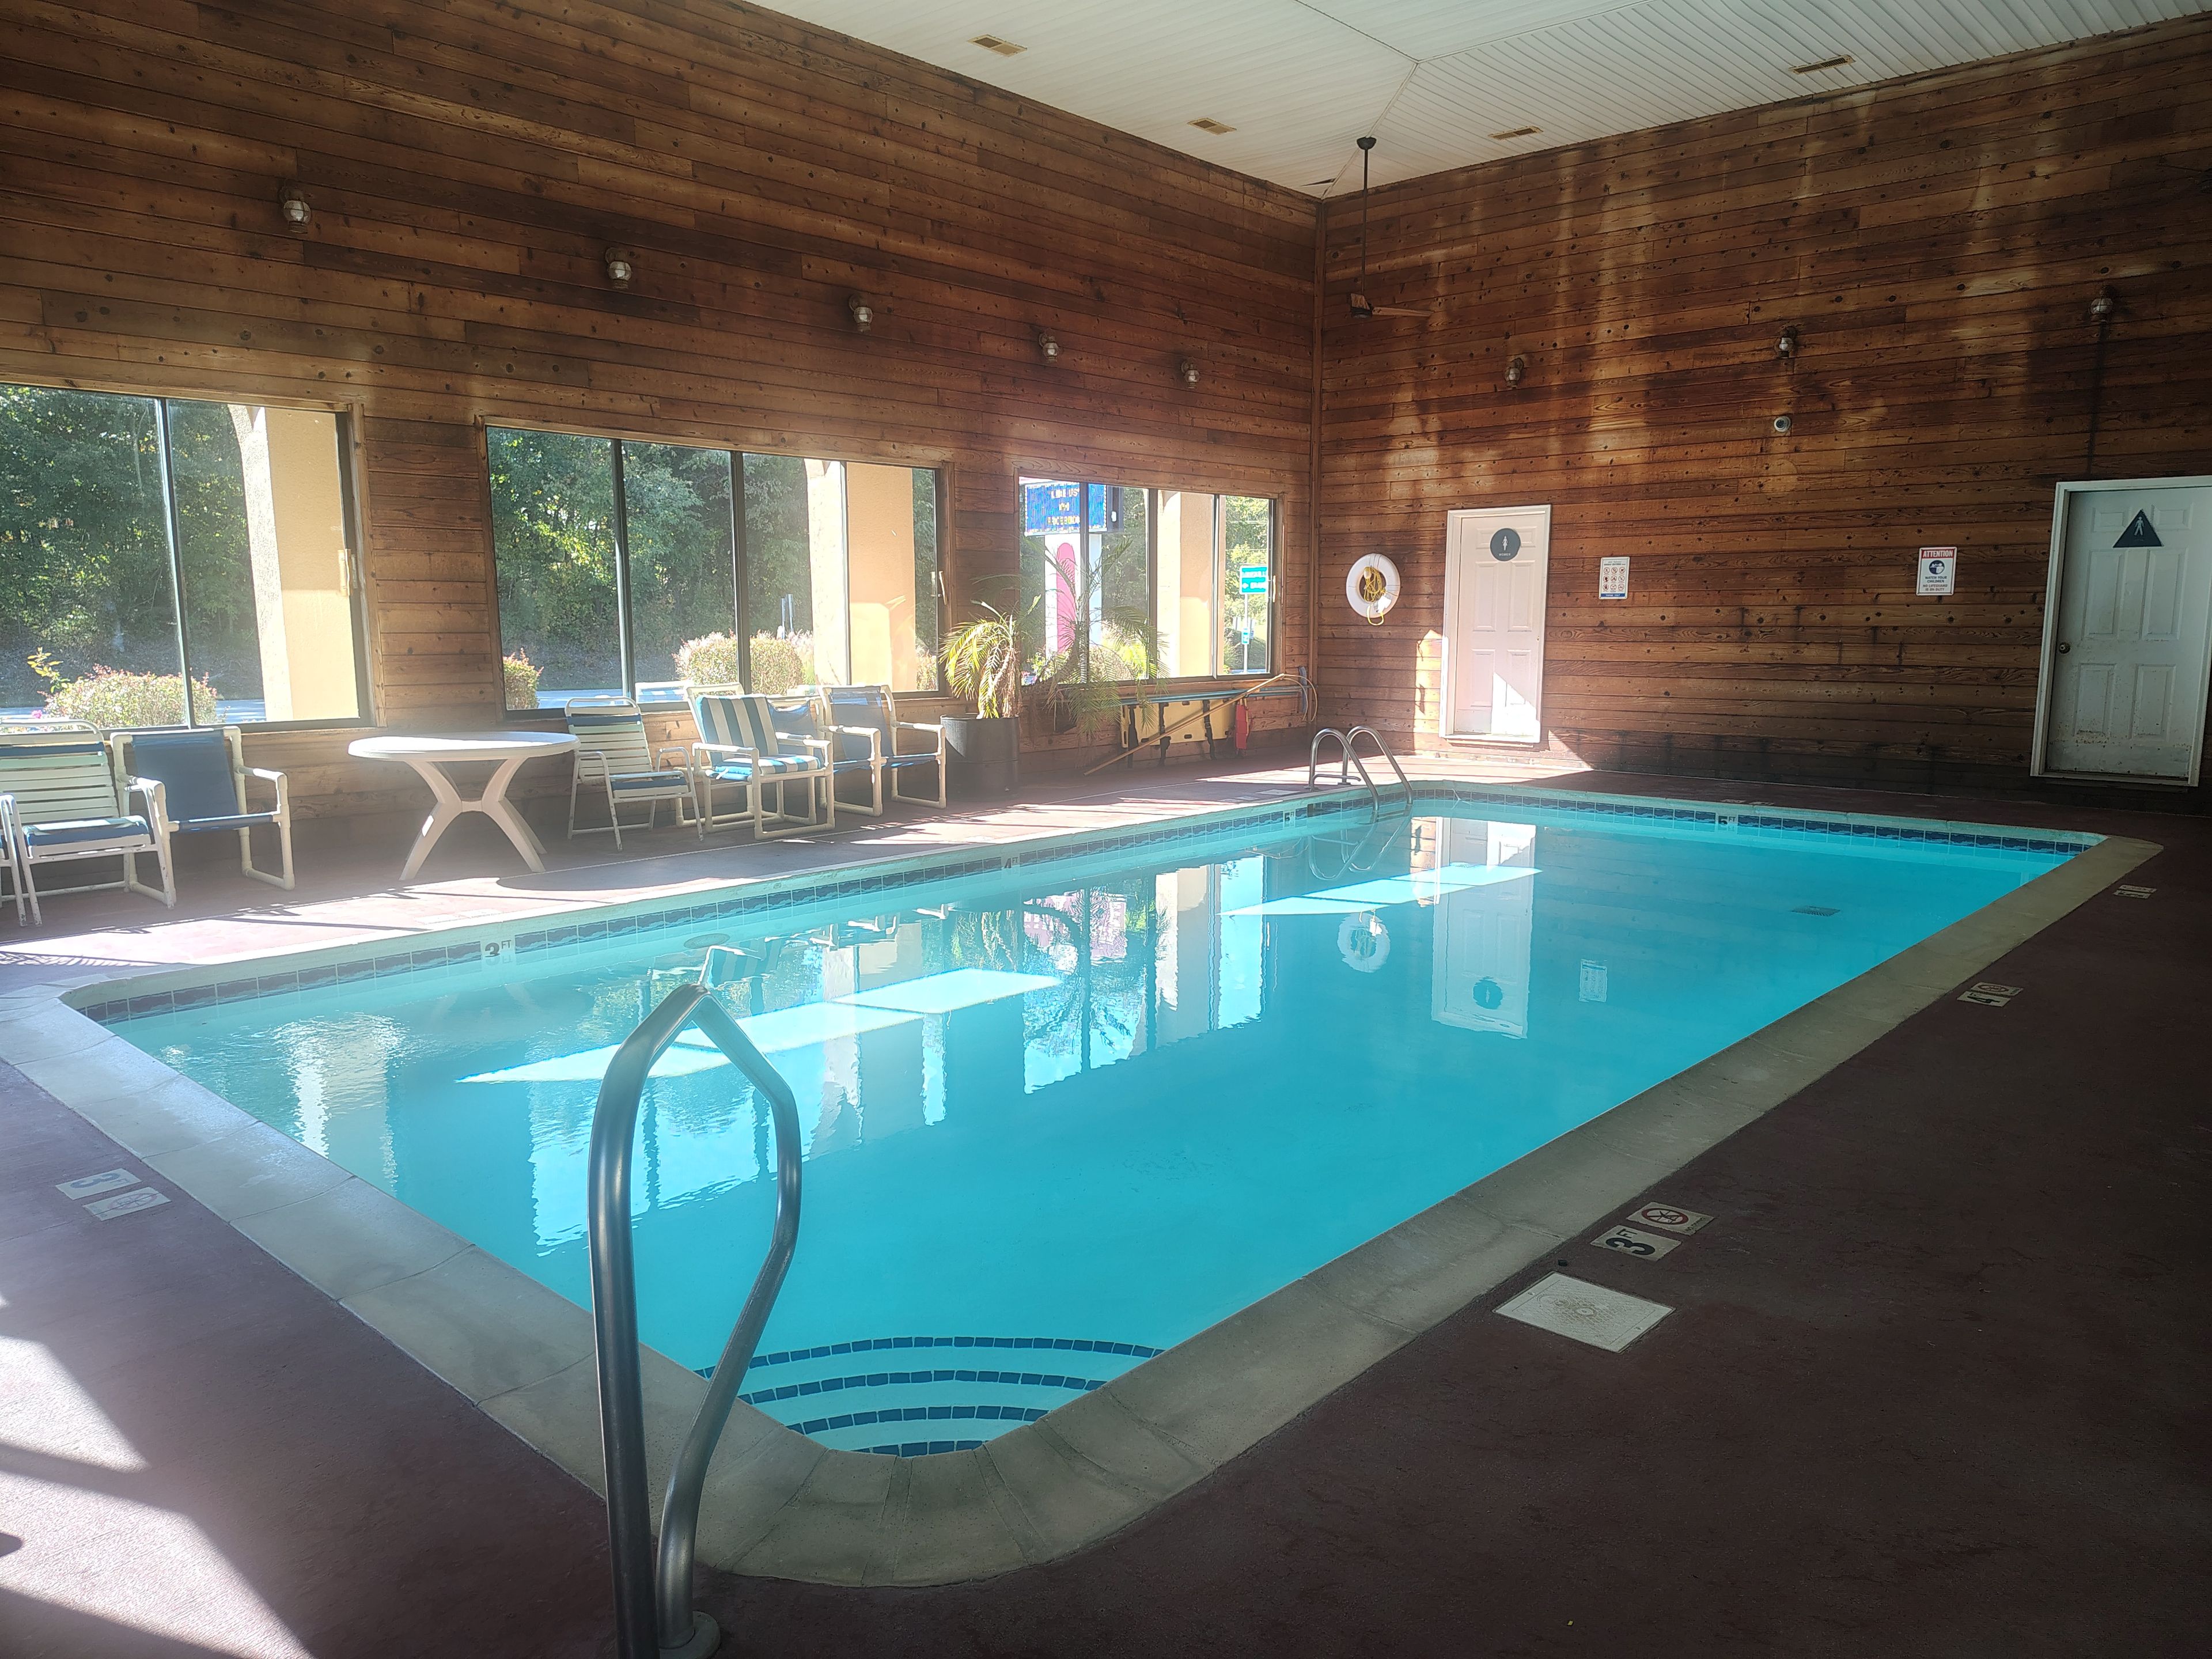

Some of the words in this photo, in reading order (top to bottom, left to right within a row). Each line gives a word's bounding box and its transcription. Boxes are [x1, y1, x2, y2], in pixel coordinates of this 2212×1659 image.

[1923, 550, 1953, 558] ATTENTION
[1285, 812, 1290, 821] 5
[1718, 816, 1728, 824] 5
[501, 940, 512, 949] FT
[1967, 995, 2001, 1003] 4
[70, 1173, 120, 1188] 3
[1616, 1228, 1638, 1238] FT
[1605, 1237, 1656, 1255] 3
